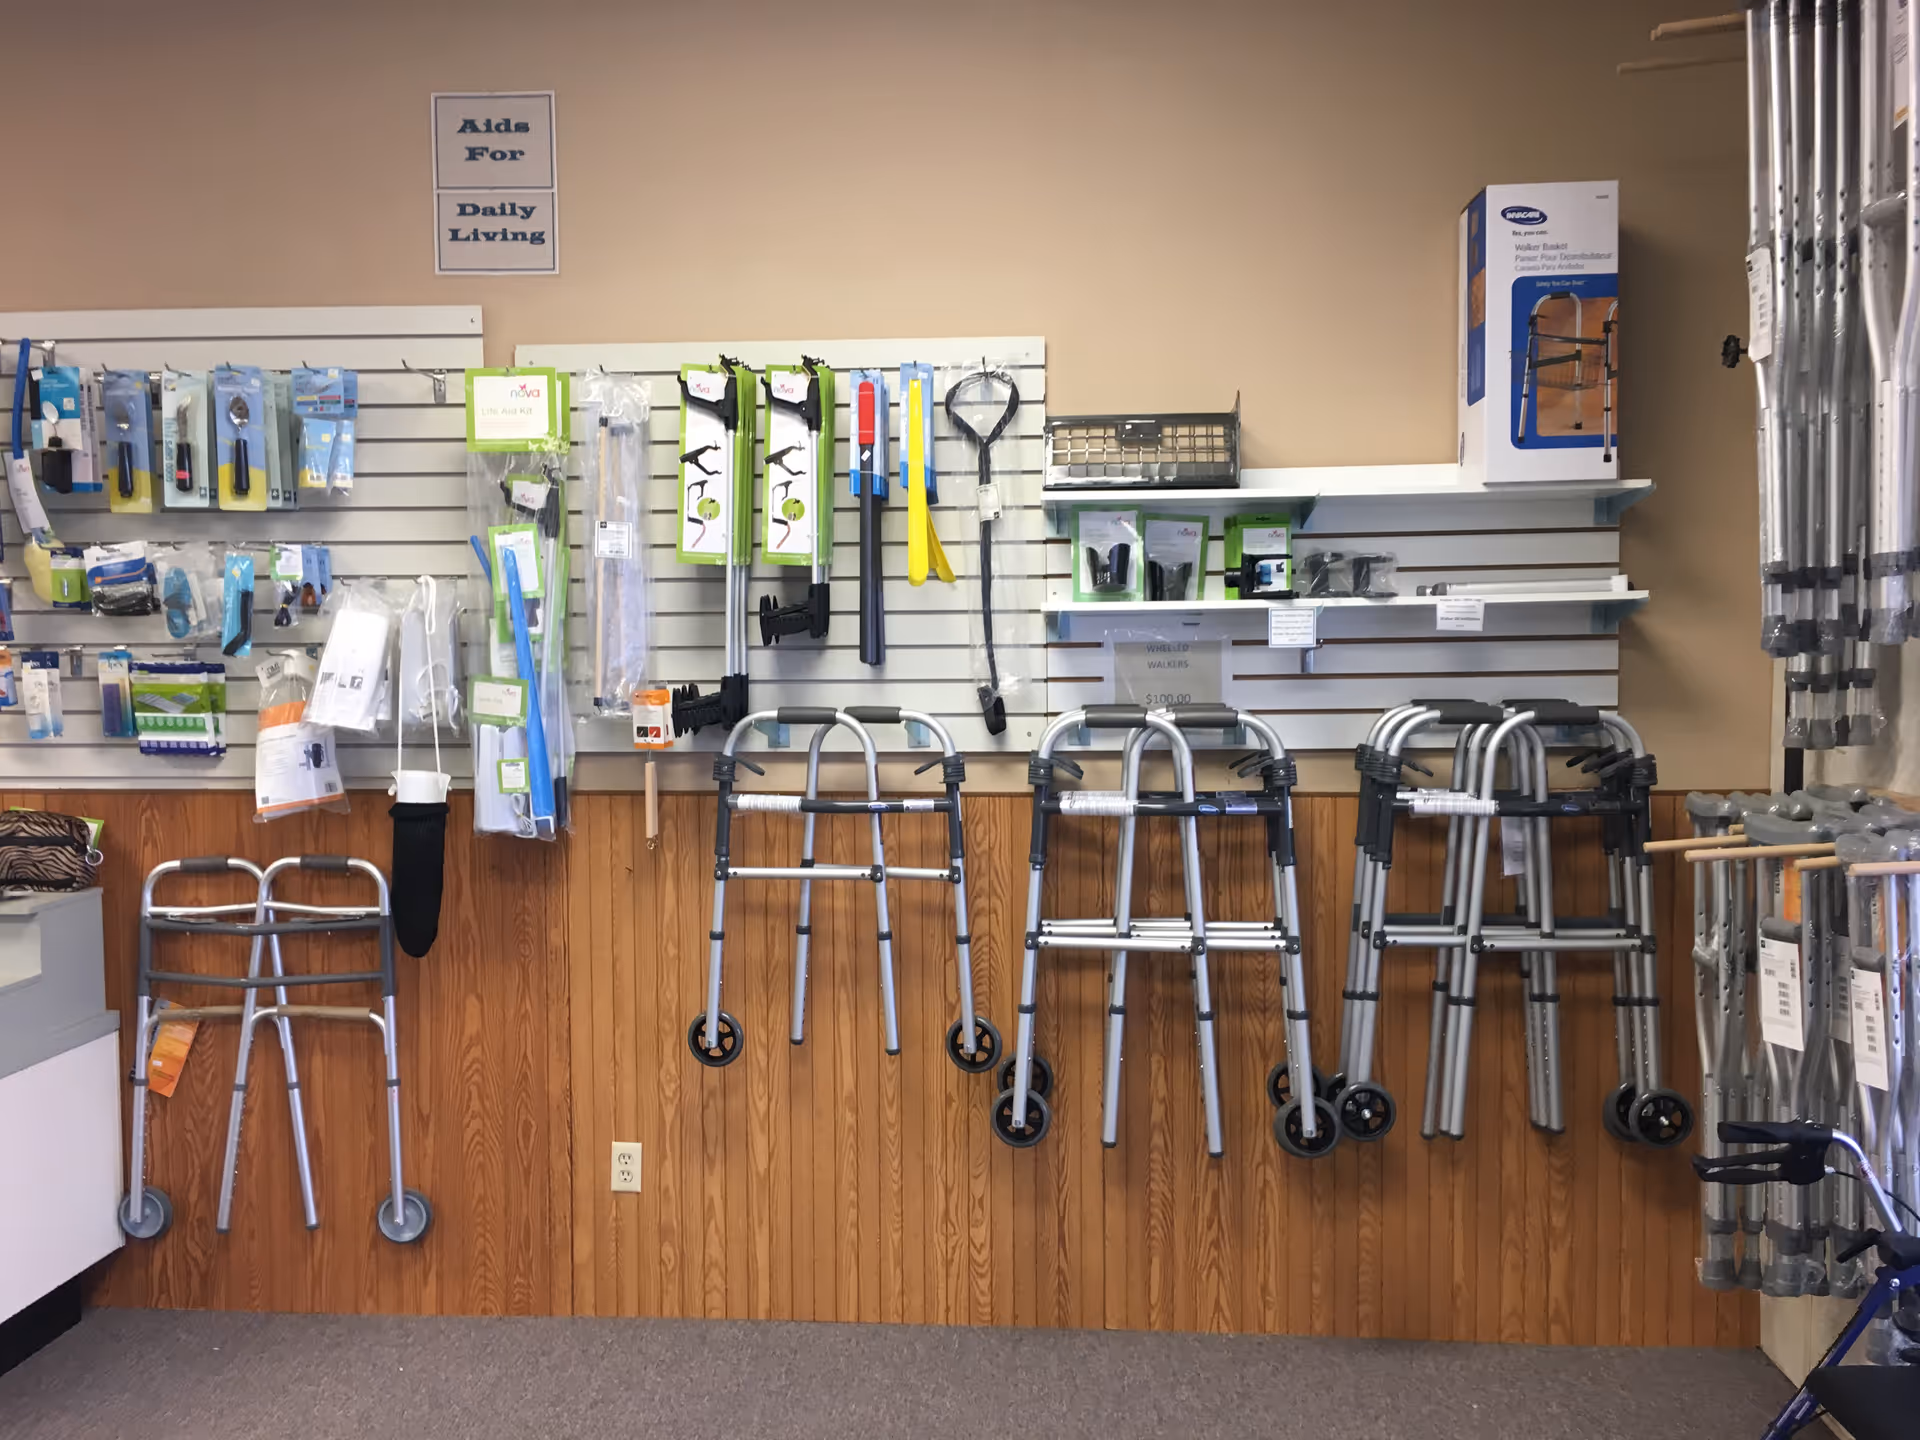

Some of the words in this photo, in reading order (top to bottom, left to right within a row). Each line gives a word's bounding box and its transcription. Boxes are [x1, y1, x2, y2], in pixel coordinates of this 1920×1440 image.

[456, 118, 530, 133] Aids
[464, 146, 525, 161] For
[456, 202, 537, 219] Daily
[448, 228, 545, 245] Living
[1515, 243, 1540, 252] Walker
[1542, 242, 1568, 251] Basket
[510, 388, 541, 398] nova
[689, 386, 710, 394] nova
[773, 386, 794, 394] nova
[481, 407, 499, 416] Life
[501, 407, 517, 416] Aid
[519, 407, 532, 416] Kit
[1147, 660, 1189, 669] WALKERS
[1146, 693, 1191, 705] $100.00
